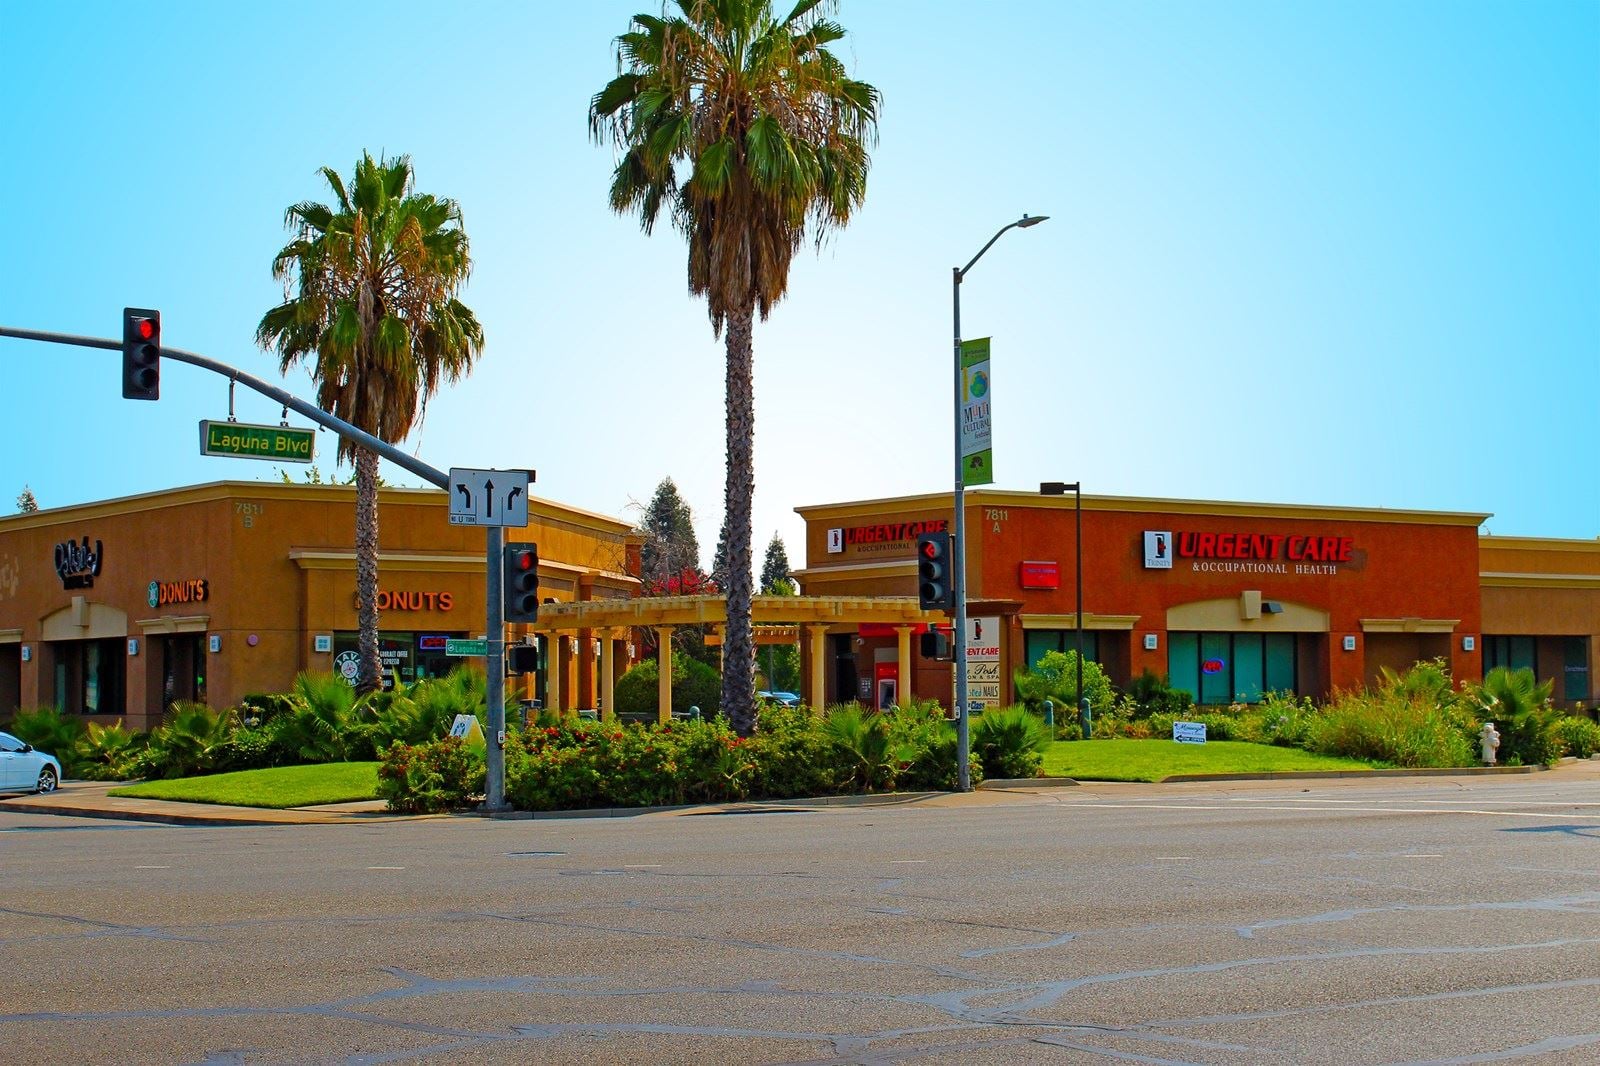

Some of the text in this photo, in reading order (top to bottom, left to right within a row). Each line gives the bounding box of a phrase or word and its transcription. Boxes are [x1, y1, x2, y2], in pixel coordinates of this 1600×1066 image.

[210, 431, 309, 453] Laguna Blvd
[235, 502, 263, 514] 7811
[985, 509, 1008, 521] 7811
[244, 516, 253, 528] B
[993, 522, 1001, 533] A
[845, 520, 946, 544] URGENT CARE
[1178, 532, 1354, 562] URGENT CARE
[1295, 564, 1337, 575] HEALTH
[160, 579, 204, 604] DONUTS
[980, 648, 999, 656] CARE
[983, 686, 998, 697] NAILS
